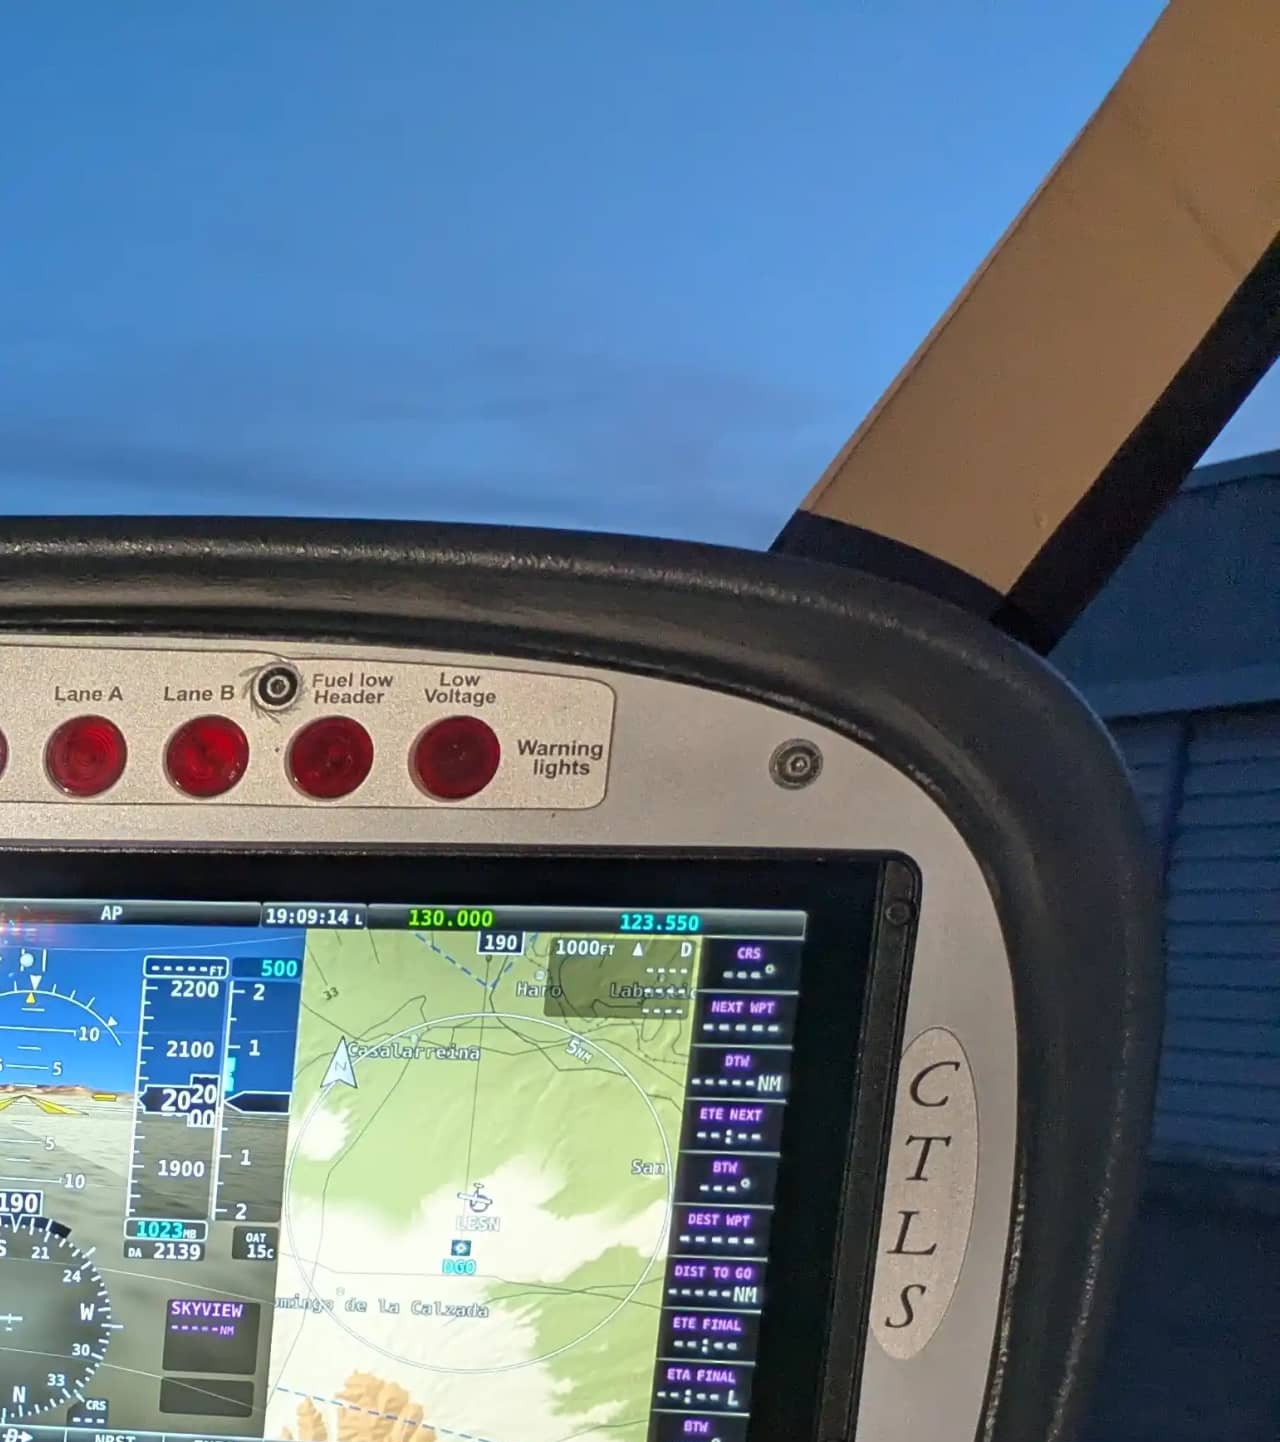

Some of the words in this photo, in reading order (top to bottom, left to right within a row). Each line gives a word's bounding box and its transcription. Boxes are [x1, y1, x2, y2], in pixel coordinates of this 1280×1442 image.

[312, 673, 353, 689] Fuel
[361, 673, 393, 688] low
[439, 672, 480, 687] Low
[54, 685, 99, 701] Lane
[105, 685, 123, 701] A
[164, 685, 208, 701] Lane
[219, 686, 235, 701] B
[314, 689, 384, 705] Header
[424, 689, 496, 707] Voltage
[517, 740, 603, 761] Warning
[532, 757, 591, 778] lights
[409, 909, 493, 928] 130.000
[620, 914, 699, 932] 123.550
[885, 1061, 960, 1329] CTLS
